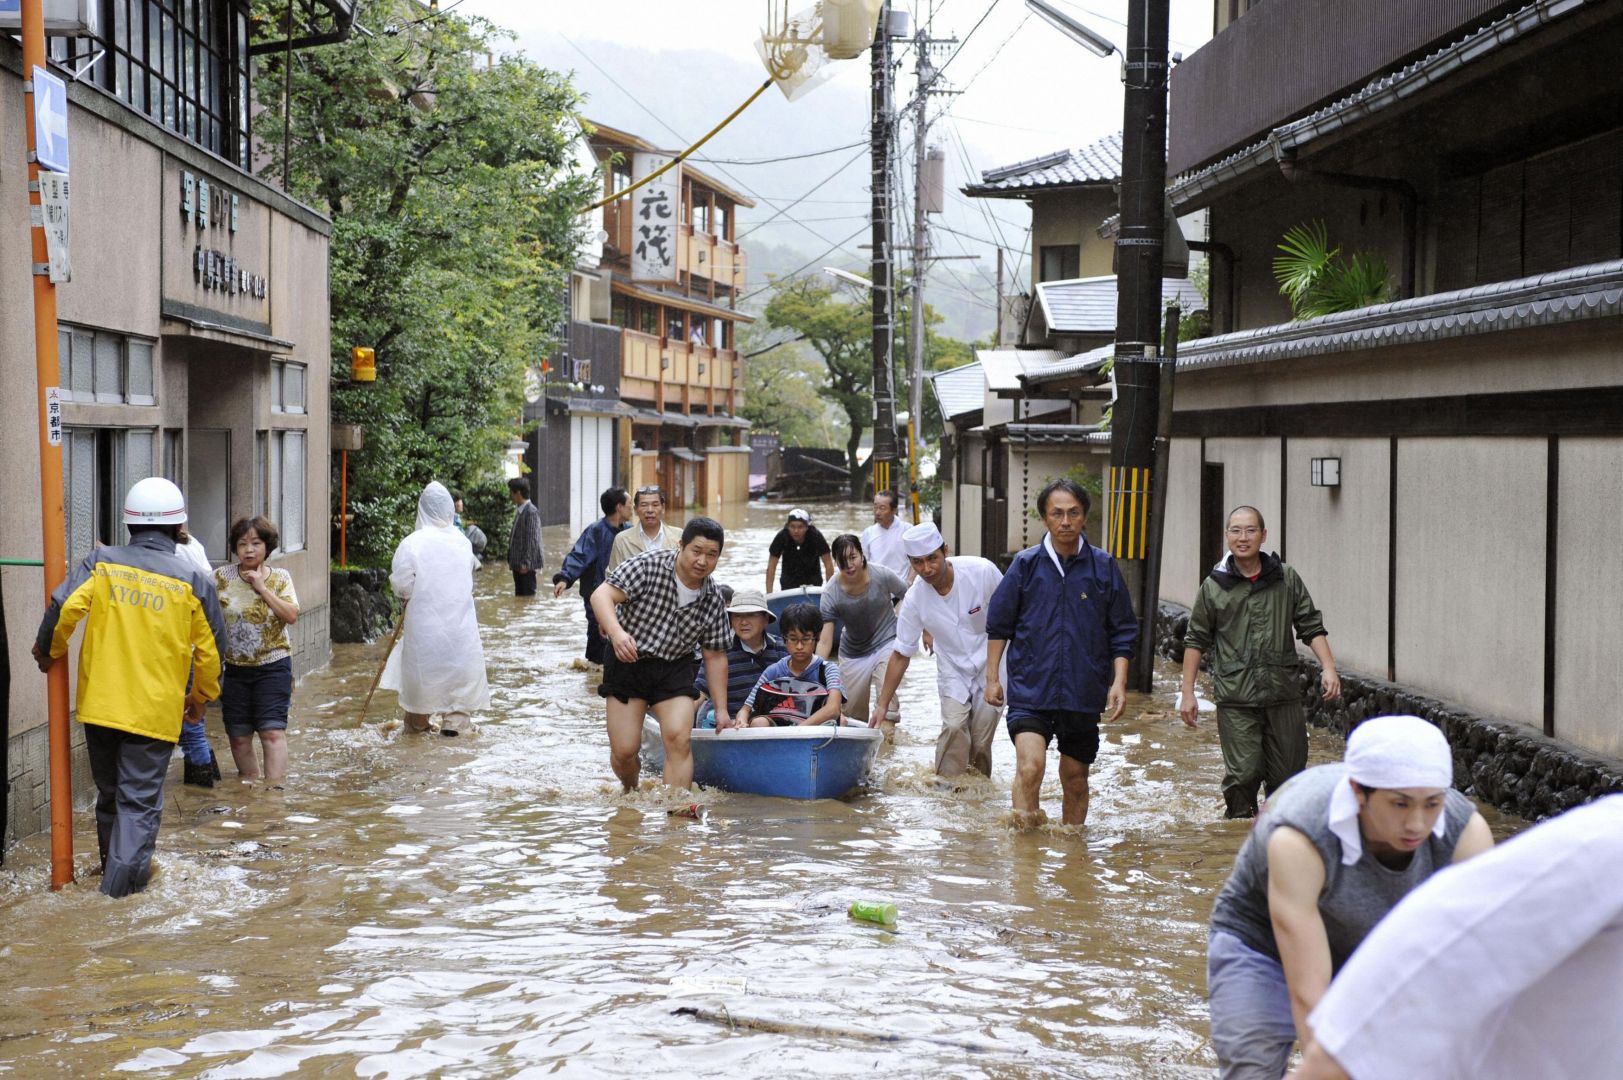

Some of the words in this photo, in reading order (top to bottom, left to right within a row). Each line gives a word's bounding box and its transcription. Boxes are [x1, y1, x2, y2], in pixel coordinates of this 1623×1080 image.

[49, 402, 61, 441] 京都市
[96, 568, 139, 582] VOLUNTEER
[140, 575, 158, 587] FIRE
[109, 584, 165, 612] KYOTO
